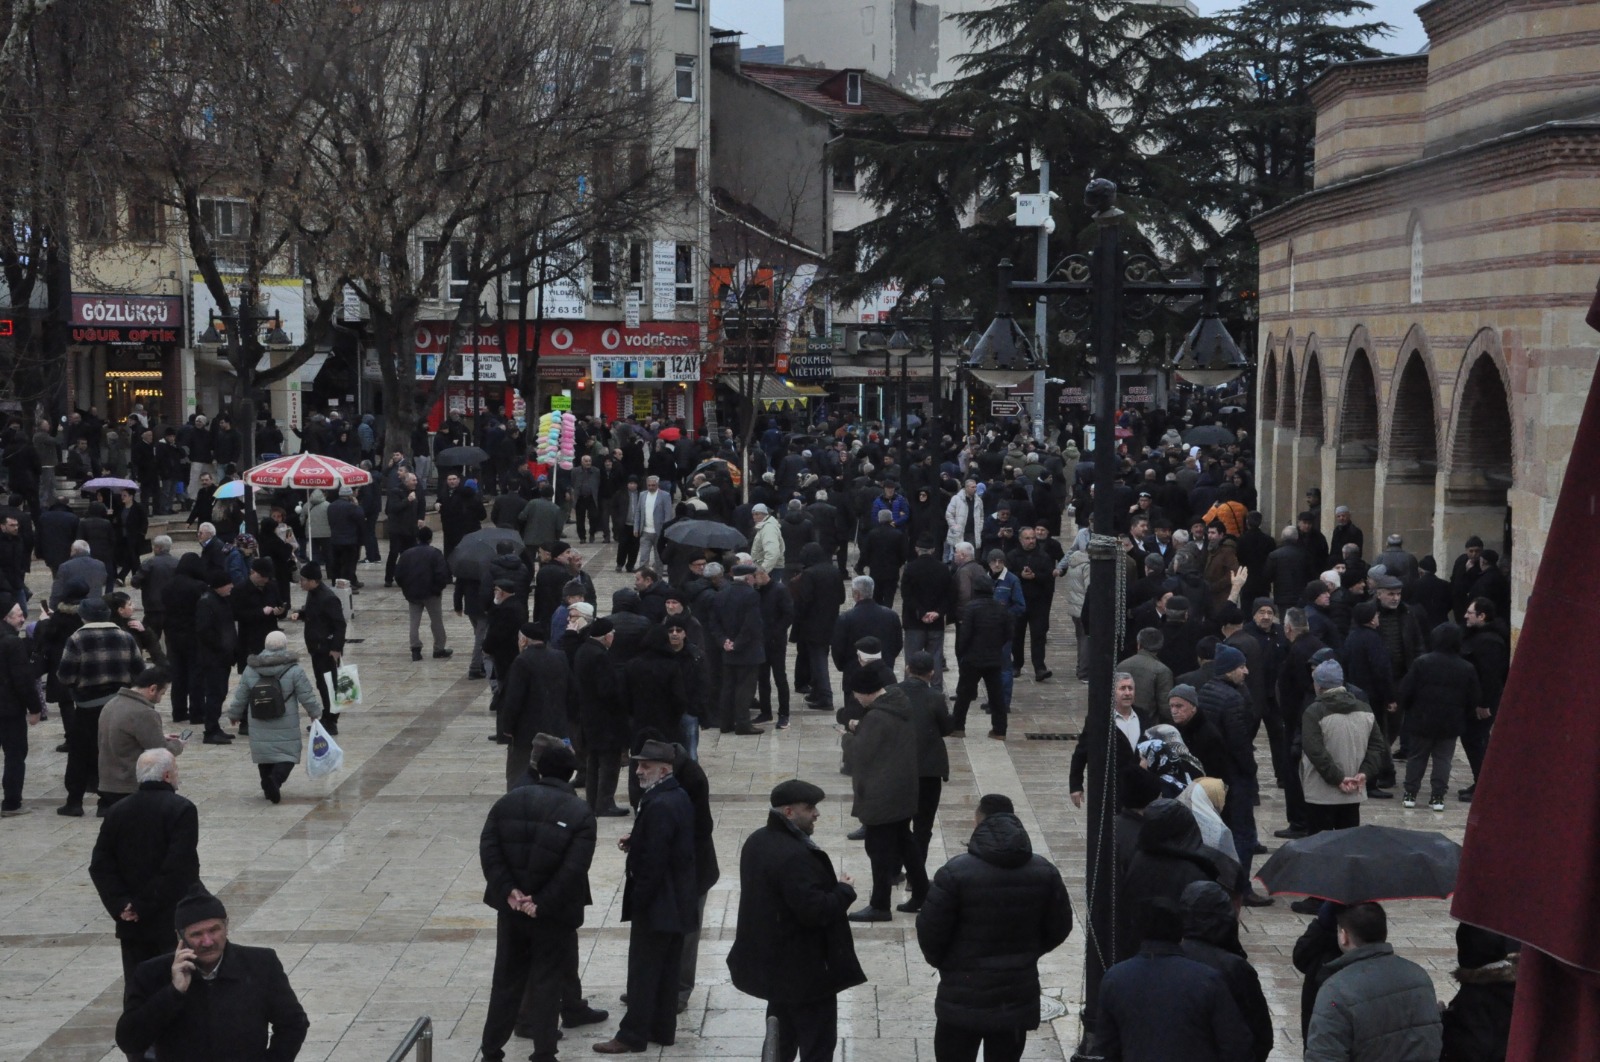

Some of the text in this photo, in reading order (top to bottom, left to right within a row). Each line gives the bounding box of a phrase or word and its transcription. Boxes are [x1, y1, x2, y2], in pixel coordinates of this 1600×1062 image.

[83, 301, 168, 325] GÖZLÜKÇÜ
[558, 306, 569, 314] 63
[72, 327, 177, 342] UĞUR OPTİK
[624, 332, 688, 347] vodafone
[671, 357, 698, 372] 12 AY
